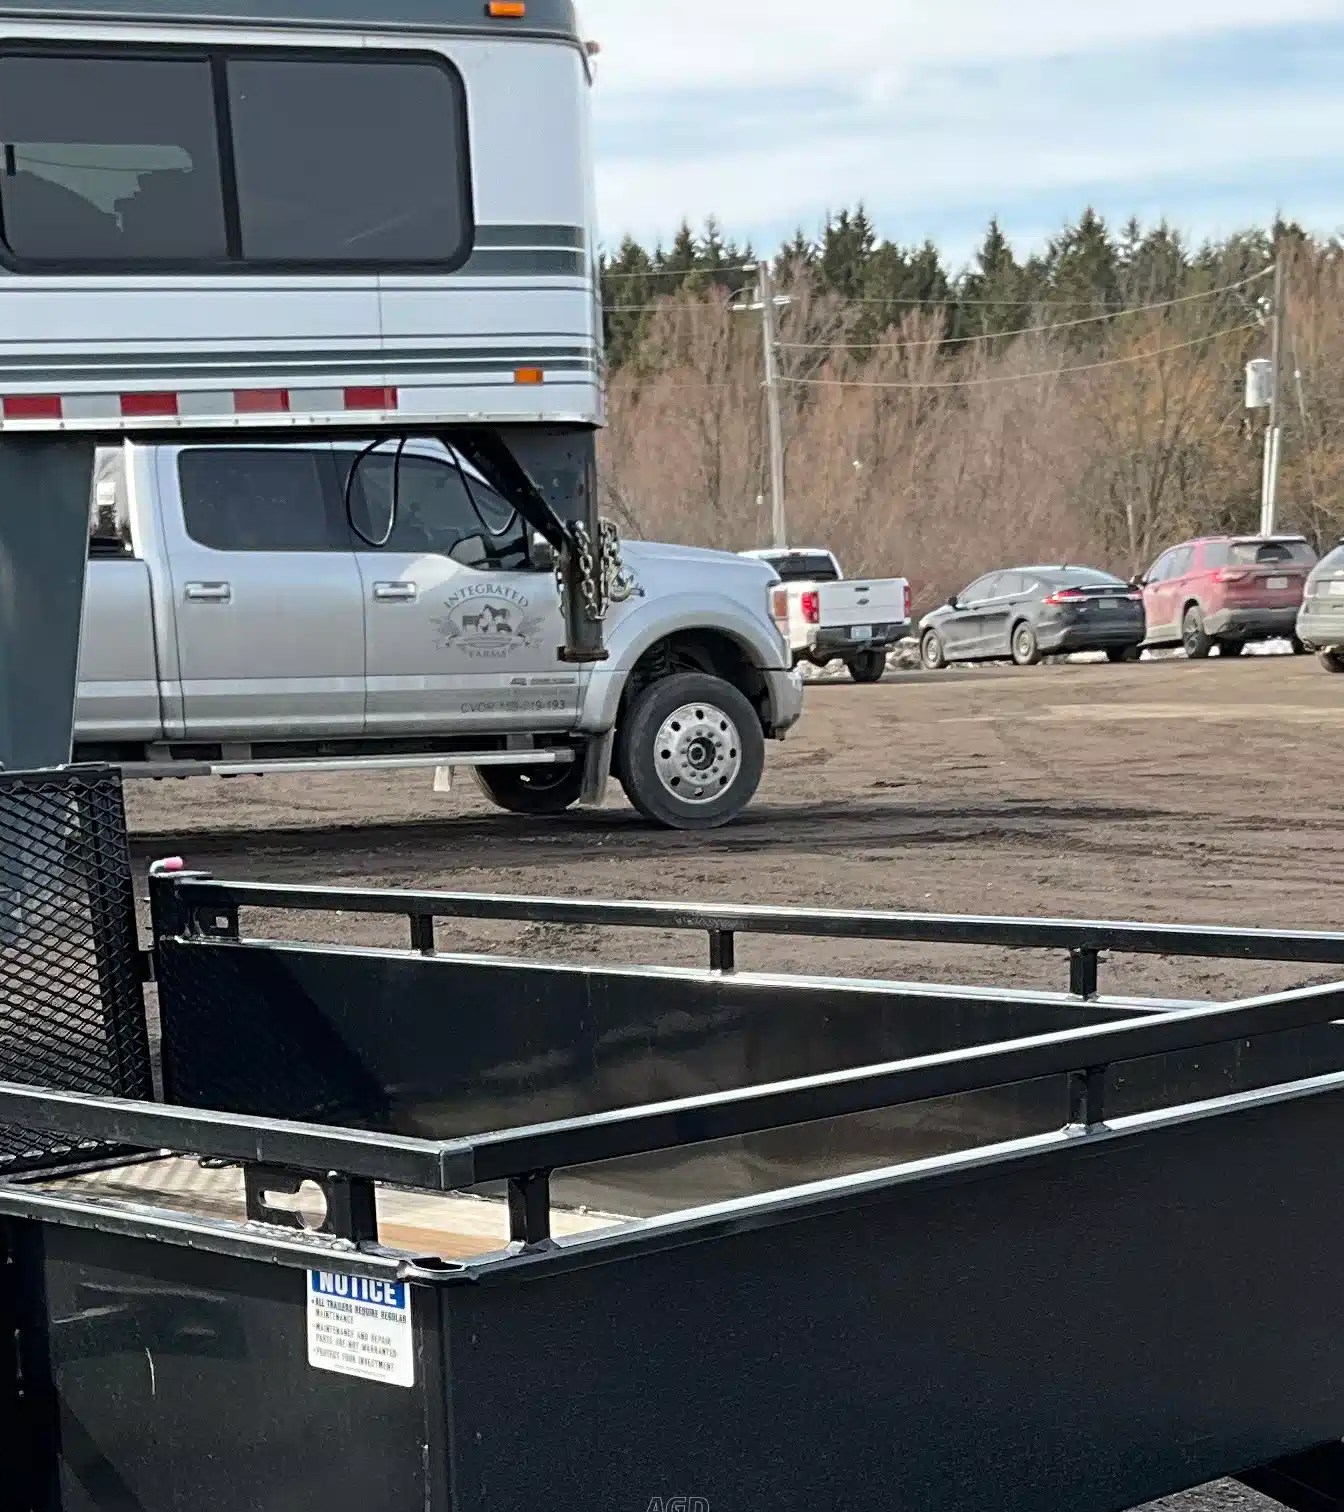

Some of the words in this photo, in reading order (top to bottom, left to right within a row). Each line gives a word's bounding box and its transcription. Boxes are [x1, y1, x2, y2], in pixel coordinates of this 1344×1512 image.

[444, 583, 529, 609] INTEGRATED
[319, 1270, 397, 1305] NOTICE
[315, 1297, 325, 1308] ALL
[327, 1299, 353, 1314] TRAILERS
[355, 1305, 379, 1319] REQUIRE
[381, 1310, 407, 1324] REGULAR
[315, 1308, 355, 1325] MAINTENANCE
[316, 1323, 355, 1339] MAINTENANCE
